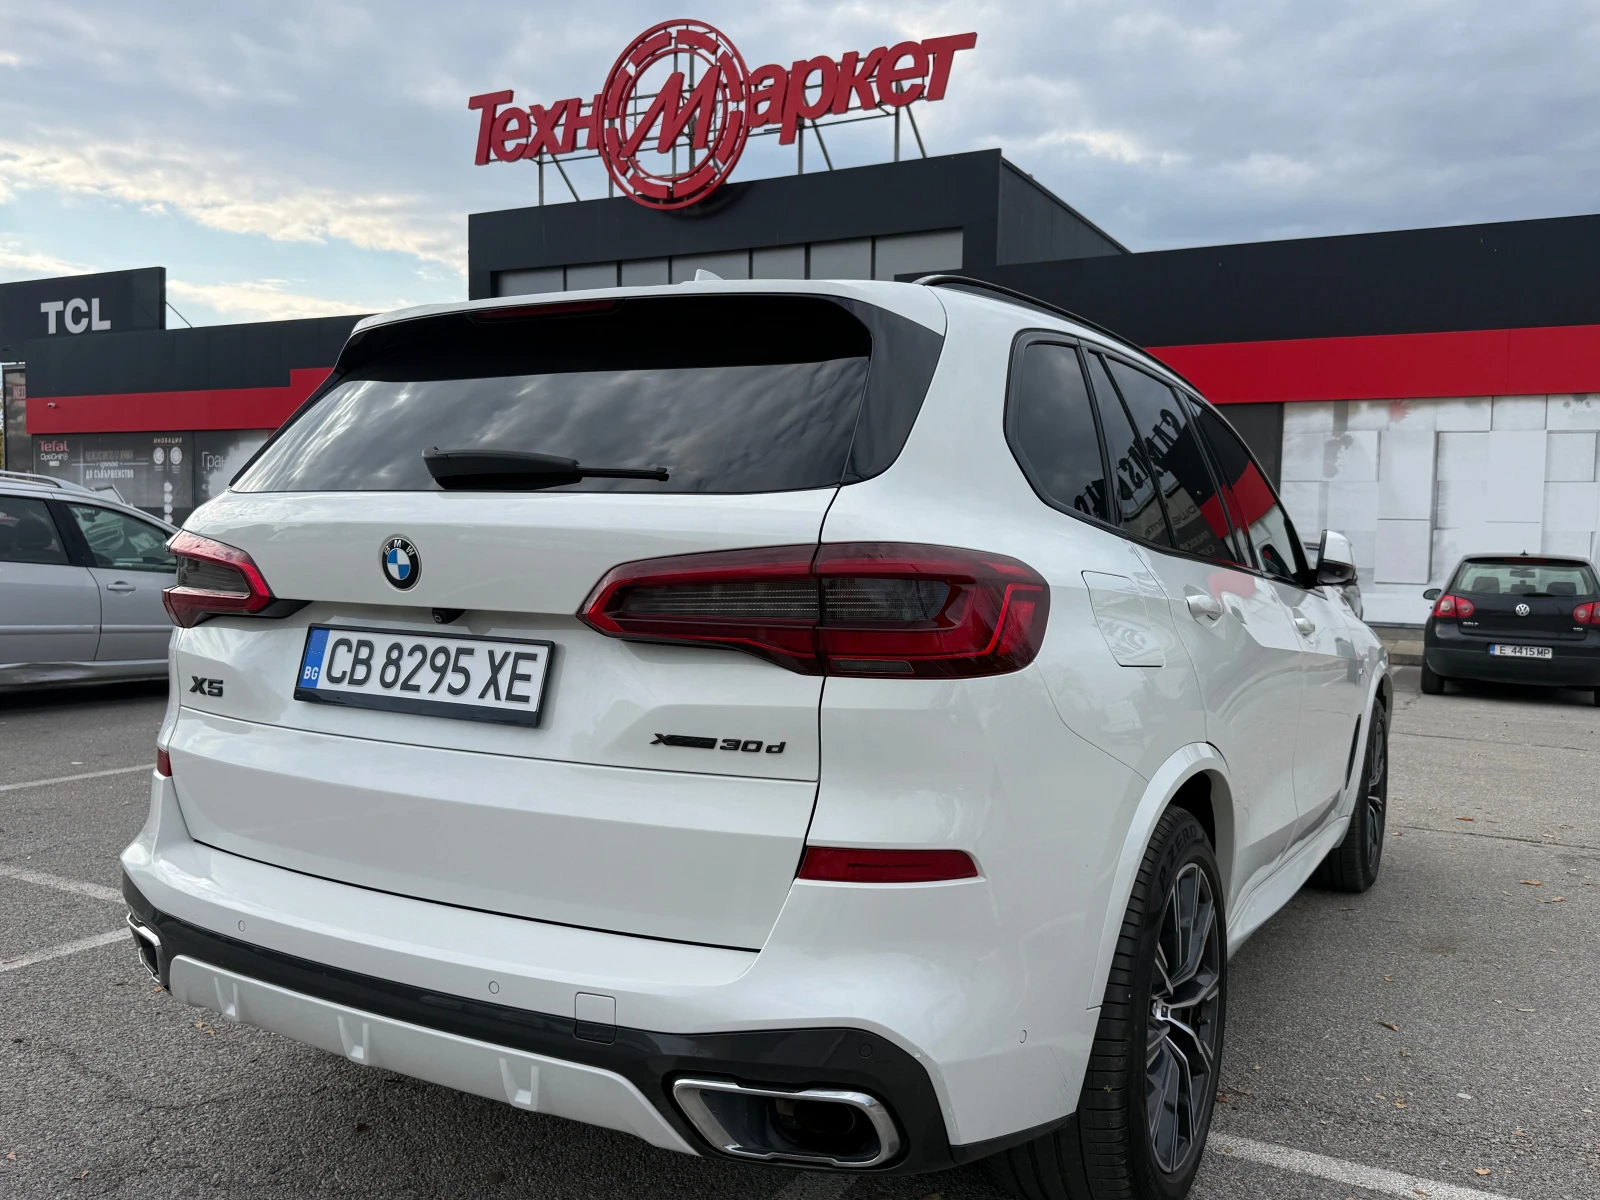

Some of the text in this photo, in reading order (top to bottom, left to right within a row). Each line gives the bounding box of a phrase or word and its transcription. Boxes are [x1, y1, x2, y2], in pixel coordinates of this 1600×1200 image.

[40, 297, 111, 334] TCL
[39, 440, 70, 452] Tefal
[384, 539, 415, 556] BMW
[1499, 645, 1506, 655] E
[1511, 646, 1536, 656] 4415
[1537, 648, 1551, 657] MP
[304, 666, 319, 680] BG
[326, 638, 538, 703] CB 8295 XE
[189, 675, 224, 697] X5
